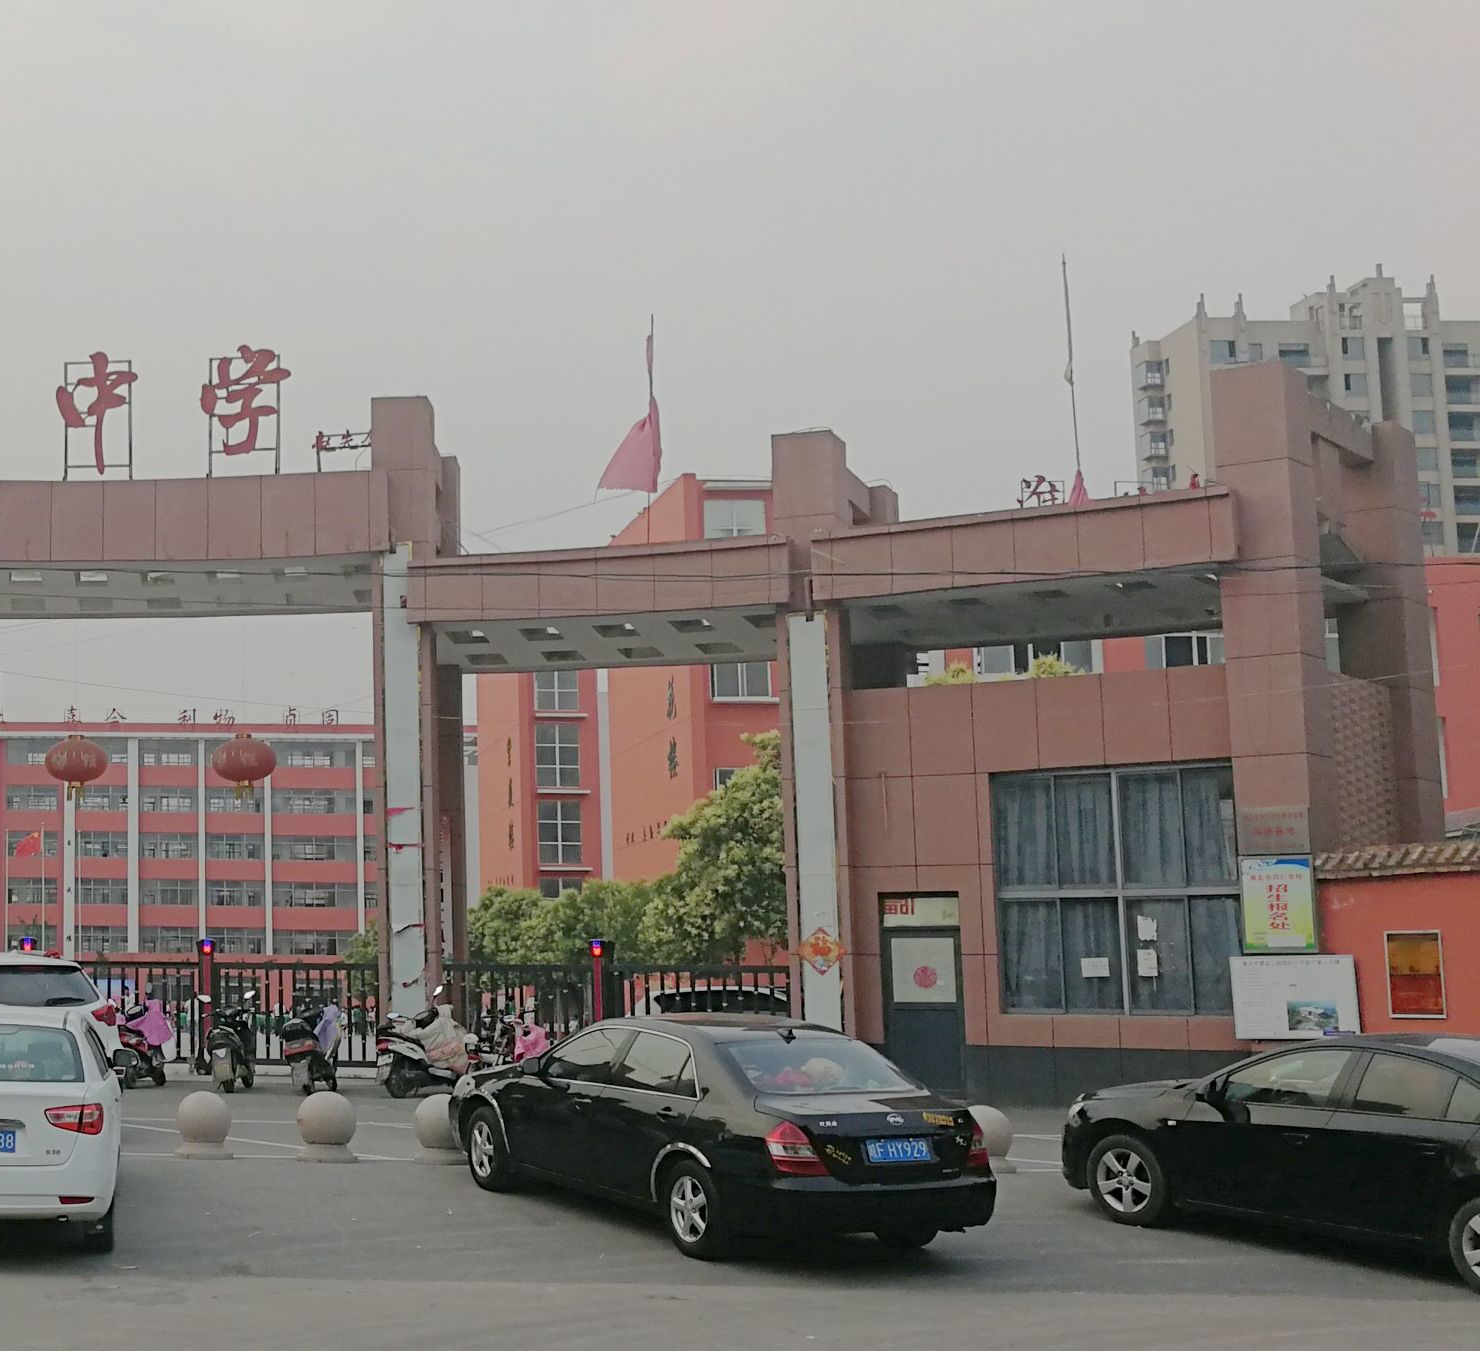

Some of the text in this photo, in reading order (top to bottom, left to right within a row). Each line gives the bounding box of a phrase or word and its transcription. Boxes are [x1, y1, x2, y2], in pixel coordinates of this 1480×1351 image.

[1266, 884, 1290, 930] 招生报名处
